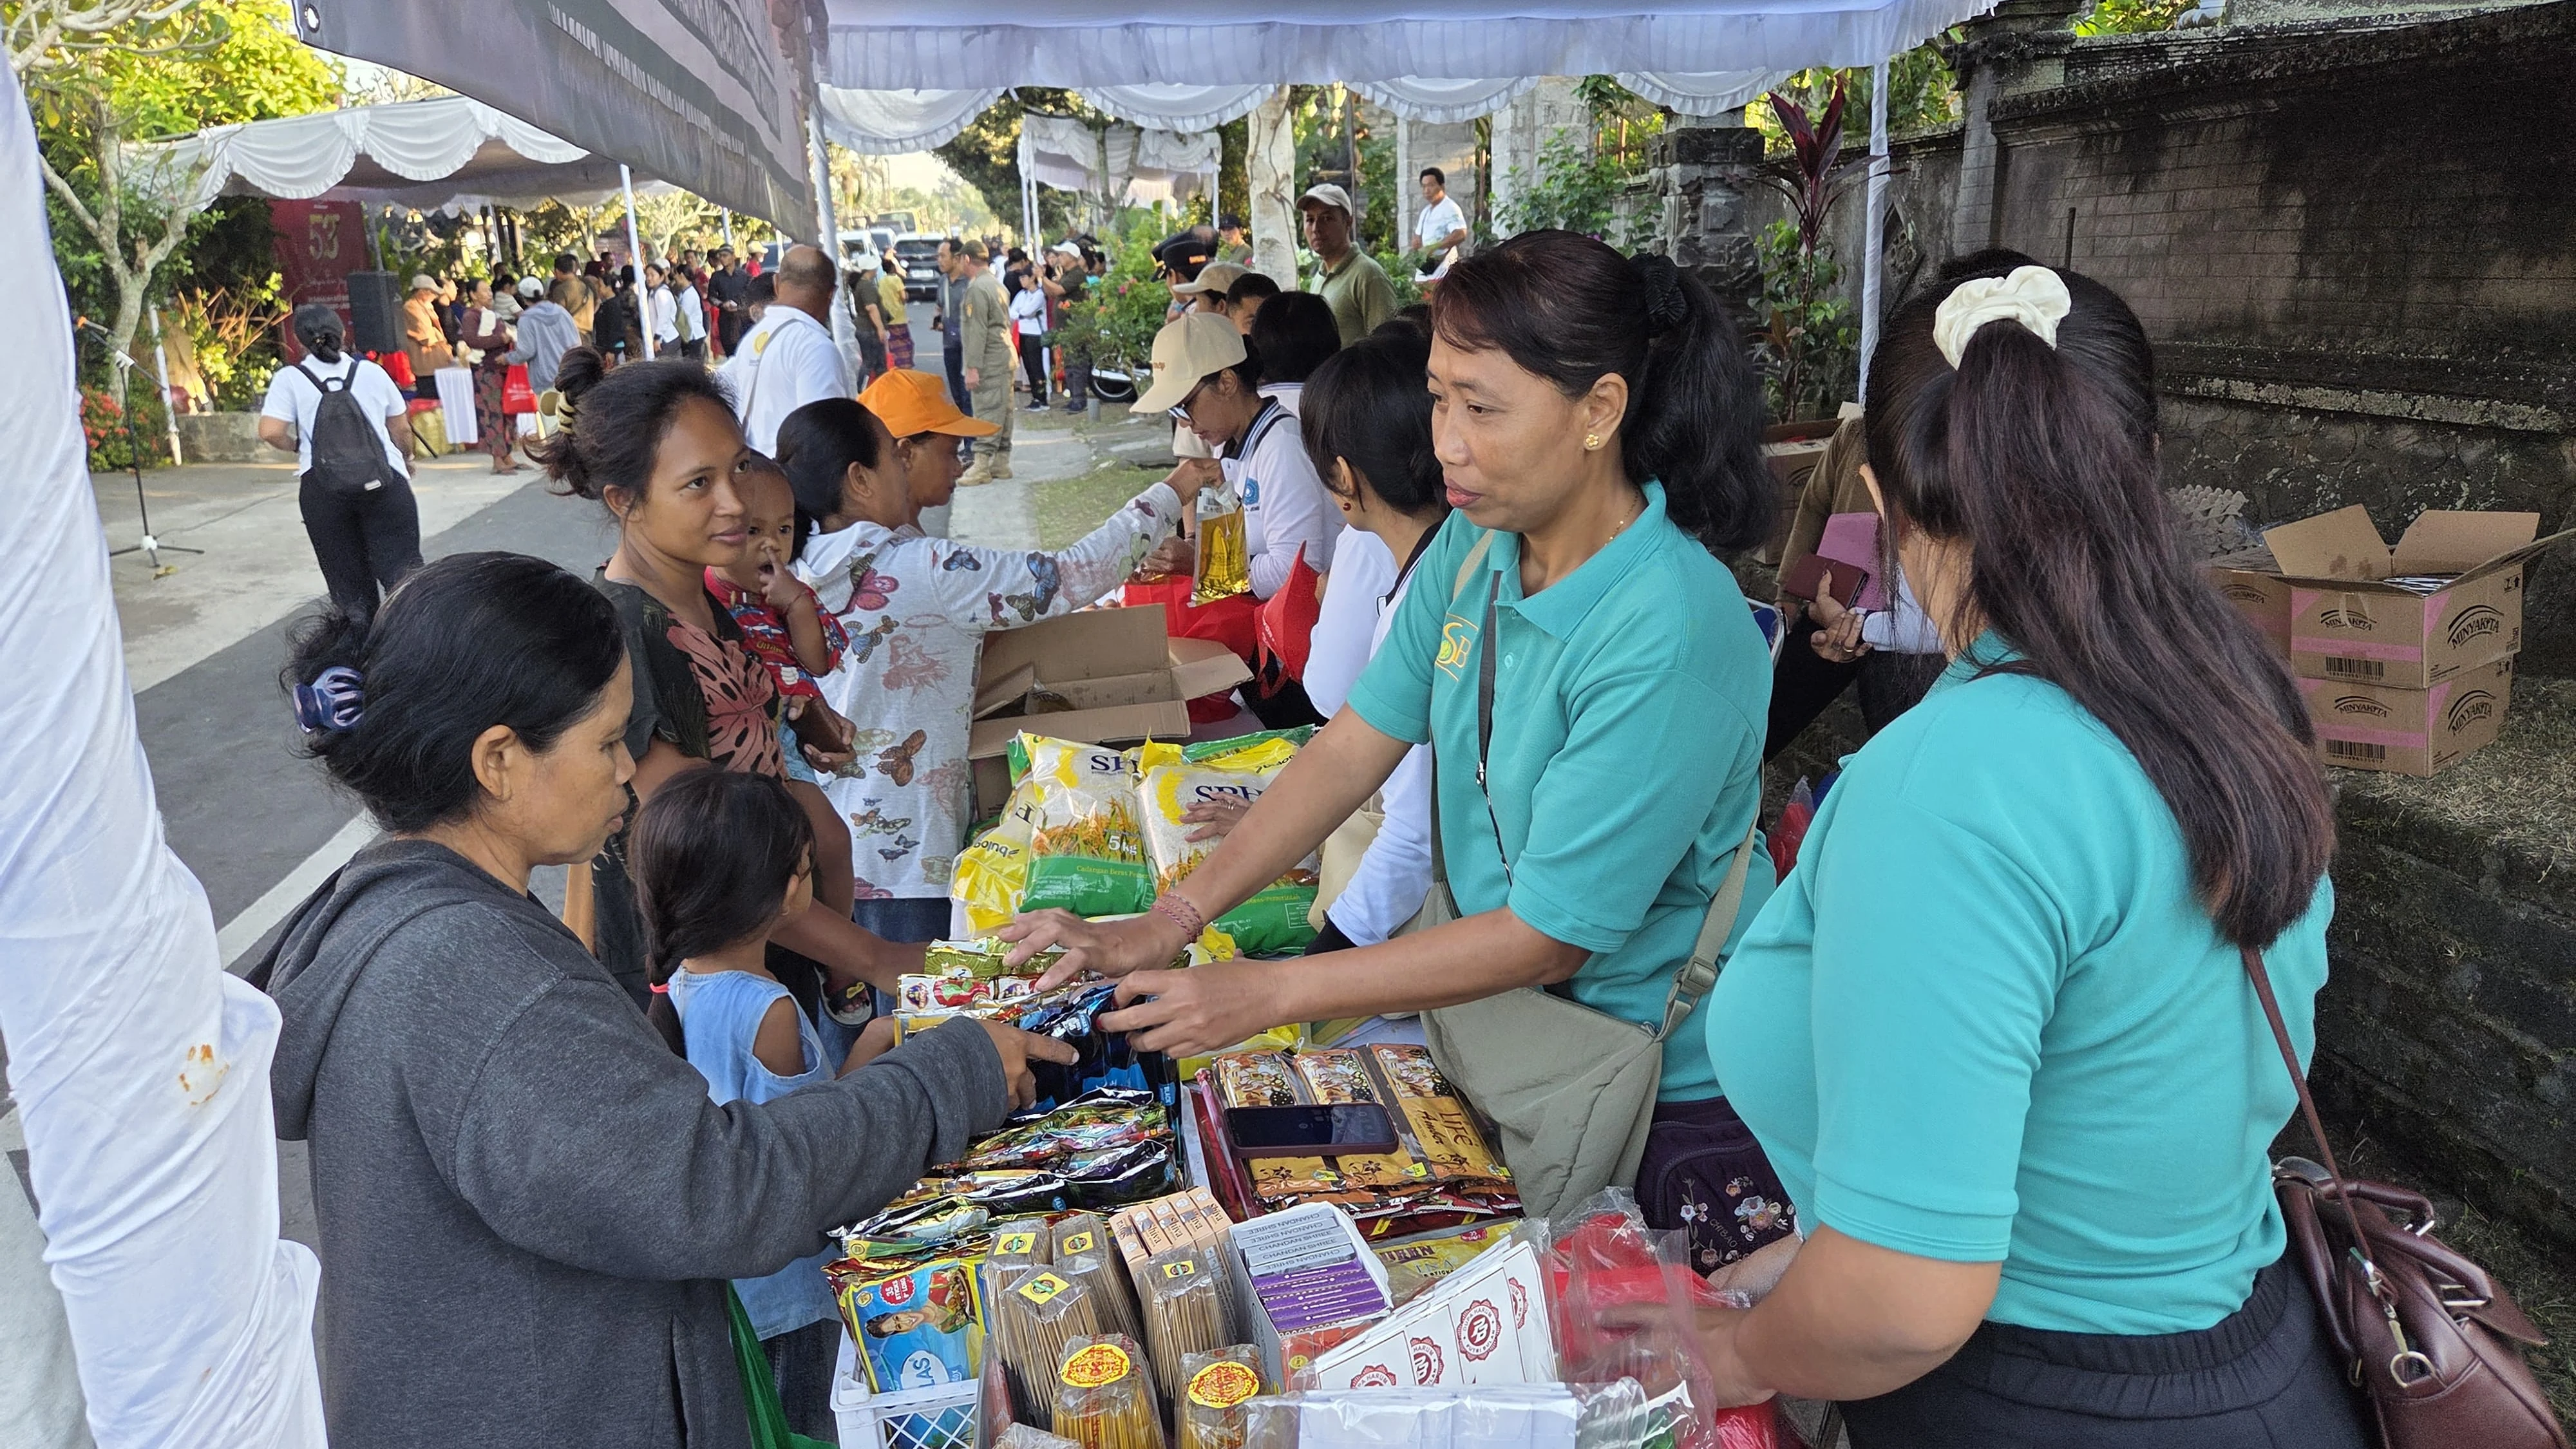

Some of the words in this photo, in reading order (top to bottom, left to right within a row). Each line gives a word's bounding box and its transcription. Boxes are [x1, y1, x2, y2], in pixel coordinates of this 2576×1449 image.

[2324, 618, 2372, 630] MINAKITA
[2452, 617, 2499, 650] MINYAKITA
[2338, 703, 2388, 717] MINYAKITA
[2451, 701, 2492, 737] MINYAKITA
[1108, 835, 1121, 851] 5
[1122, 841, 1138, 856] kg
[1437, 1112, 1474, 1146] LIFE
[1249, 1222, 1278, 1235] SHREE
[1278, 1212, 1320, 1229] CHANDAN
[1279, 1222, 1323, 1237] CHANDAN
[1148, 1222, 1162, 1245] hiva
[1251, 1232, 1280, 1244] SHREE
[1258, 1236, 1302, 1251] CHANDAN
[1303, 1230, 1331, 1243] SHREE
[1709, 1218, 1738, 1248] CHIBAO
[1262, 1245, 1307, 1260] CHANDAN
[1307, 1238, 1336, 1251] SHREE
[1296, 1249, 1340, 1265] CHANDAN
[1265, 1258, 1296, 1270] SHREE
[885, 1286, 895, 1297] 35
[1463, 1313, 1473, 1332] DUPA
[1473, 1308, 1493, 1318] HARUM
